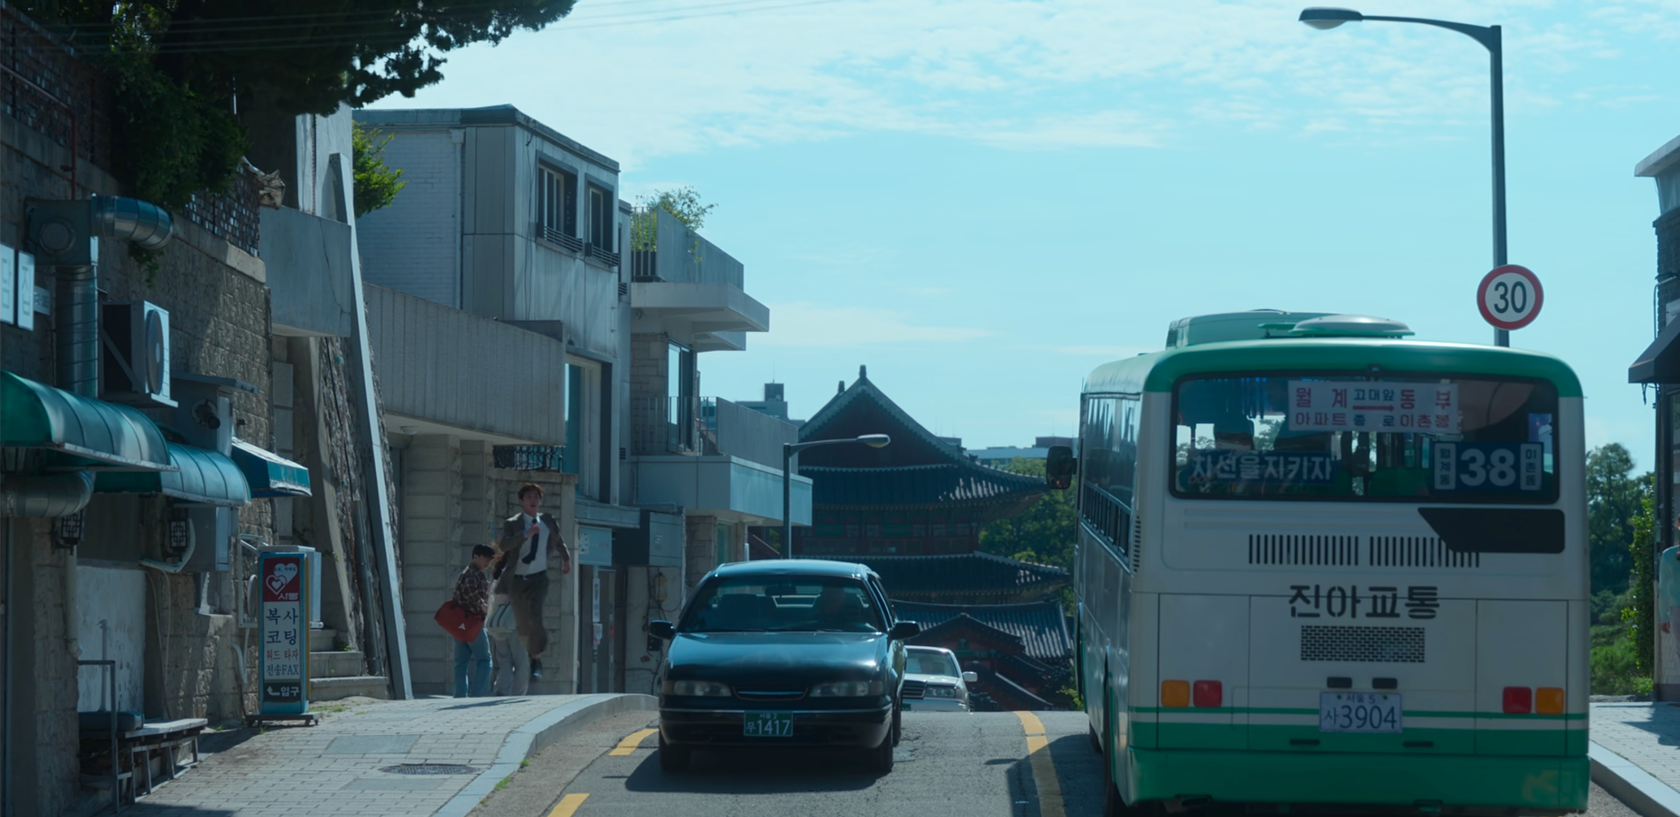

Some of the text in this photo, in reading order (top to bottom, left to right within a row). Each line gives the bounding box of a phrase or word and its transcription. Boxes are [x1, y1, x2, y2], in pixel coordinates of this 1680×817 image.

[1493, 281, 1527, 314] 30
[1295, 387, 1348, 408] 월계
[1353, 388, 1395, 402] 고대앞
[1295, 412, 1347, 426] 아파트
[1460, 448, 1516, 487] 38
[1289, 584, 1440, 619] 진아교통
[266, 608, 299, 625] 복사
[266, 628, 298, 646] 코팅
[284, 648, 299, 661] 타자
[281, 686, 300, 697] 입구
[1346, 694, 1365, 703] 서울
[1324, 705, 1397, 729] 사3904
